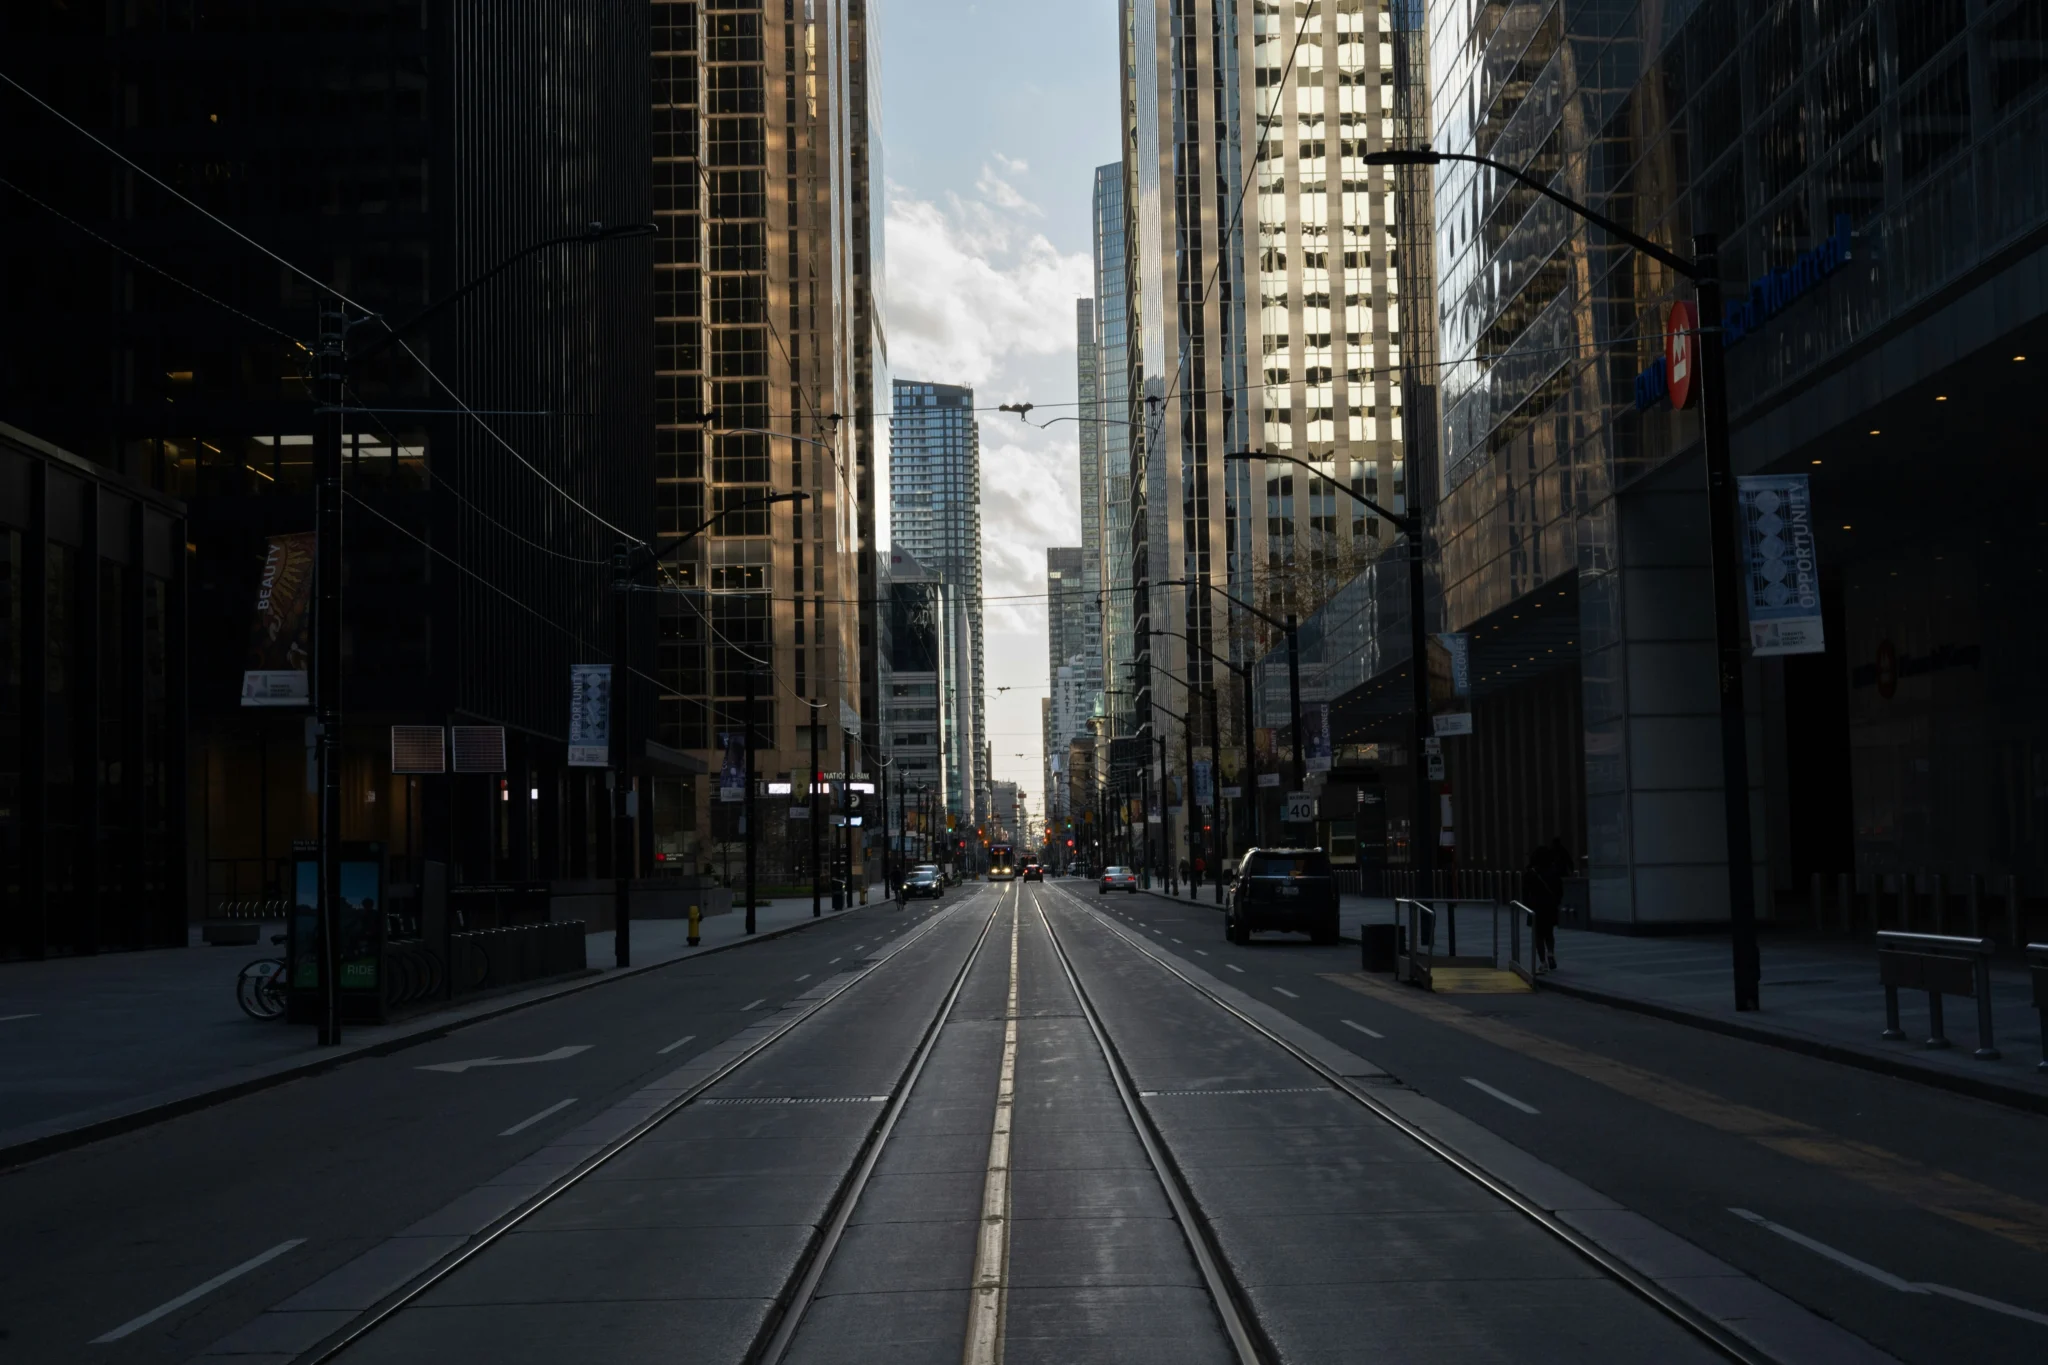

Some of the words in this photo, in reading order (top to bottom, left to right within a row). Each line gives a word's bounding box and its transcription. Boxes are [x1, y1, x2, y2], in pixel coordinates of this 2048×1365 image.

[1761, 213, 1851, 322] Montreal
[1789, 481, 1816, 609] OPPORTUNITY
[257, 544, 281, 610] BEAUTY
[1455, 637, 1466, 688] DISCOVER
[571, 668, 583, 742] OPPORTUNITY
[1320, 703, 1330, 738] CONNECT
[857, 772, 870, 780] BANK
[1290, 804, 1311, 818] 40
[347, 964, 376, 975] RIDE
